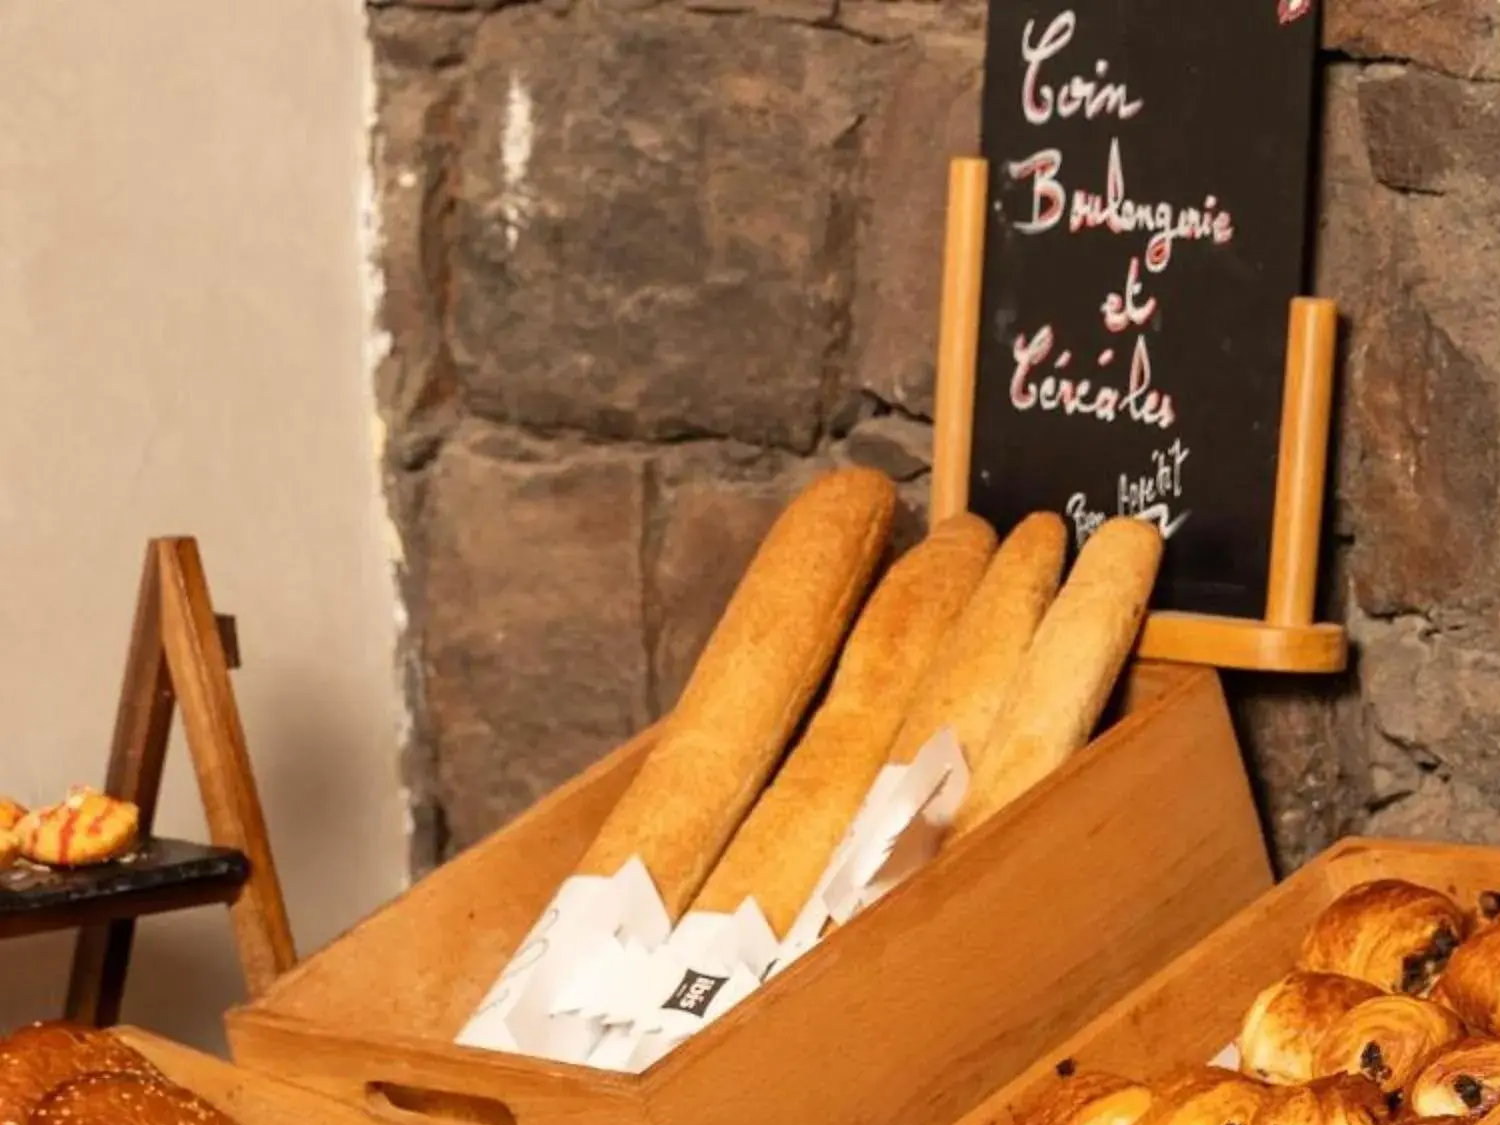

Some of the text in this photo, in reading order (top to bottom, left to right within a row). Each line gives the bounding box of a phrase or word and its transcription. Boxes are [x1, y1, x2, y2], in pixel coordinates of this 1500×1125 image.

[1021, 9, 1144, 126] Coin
[1100, 256, 1158, 333] et
[1009, 323, 1176, 429] Céréales
